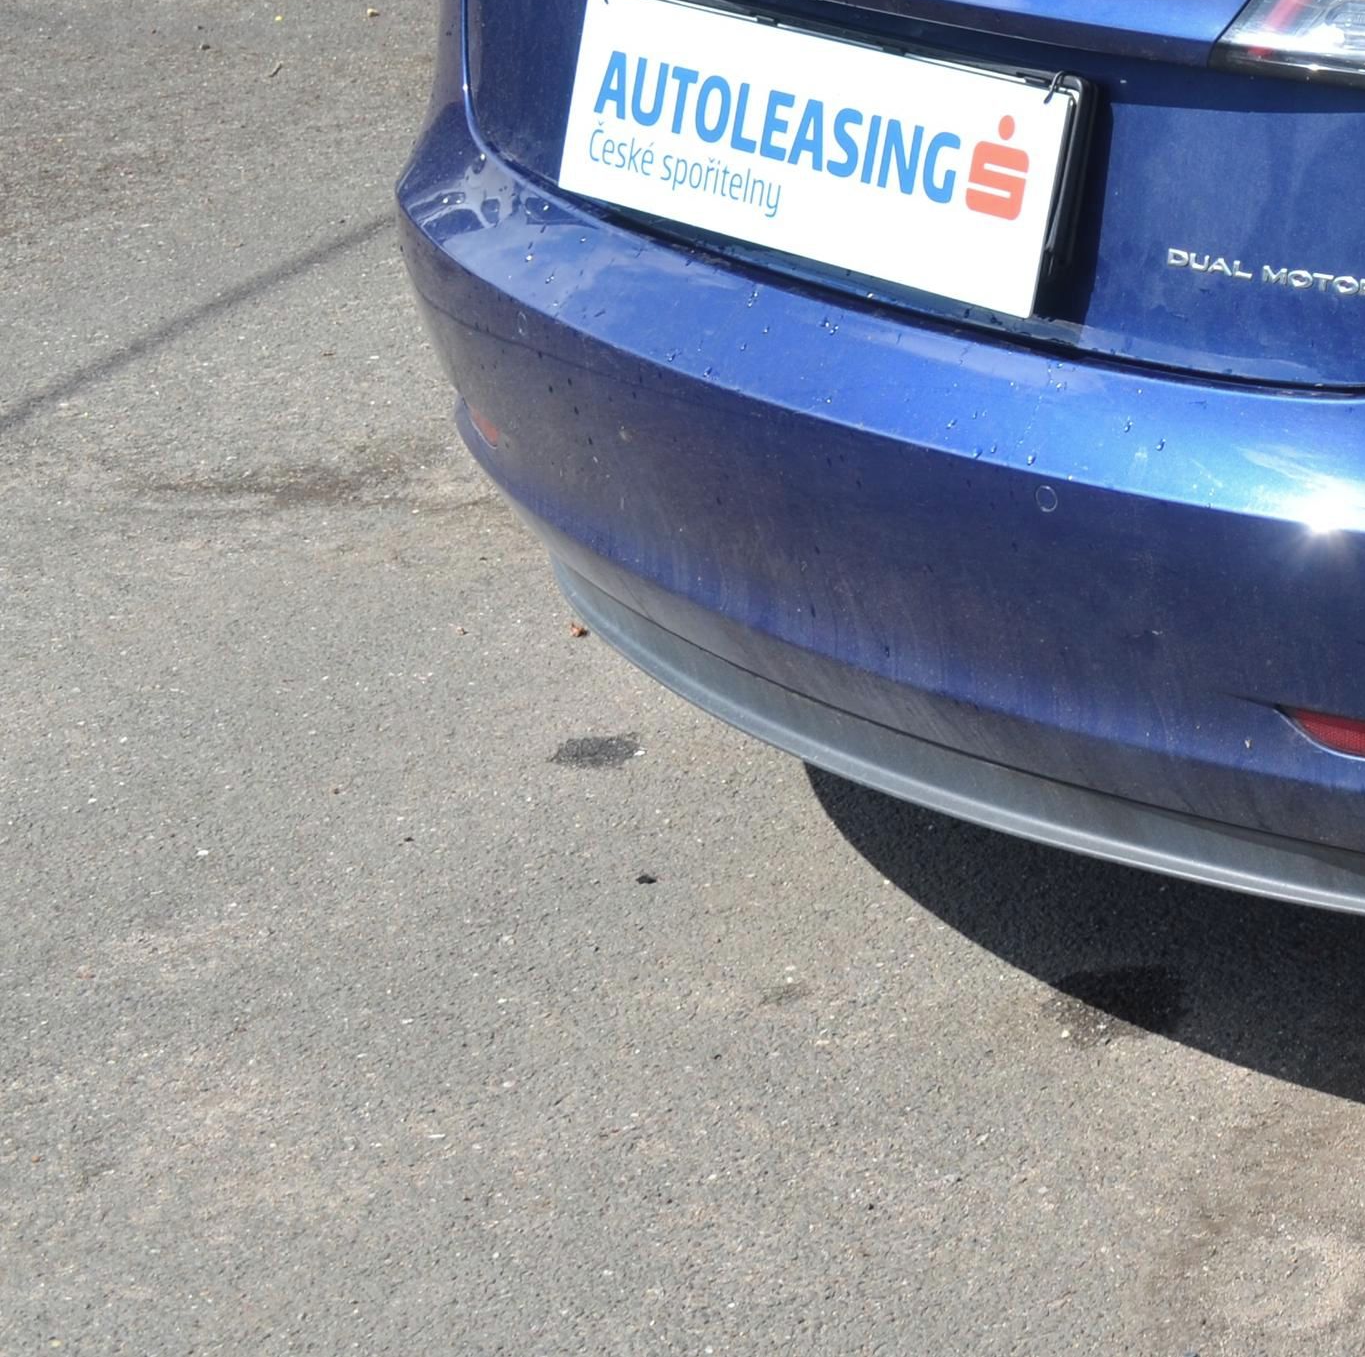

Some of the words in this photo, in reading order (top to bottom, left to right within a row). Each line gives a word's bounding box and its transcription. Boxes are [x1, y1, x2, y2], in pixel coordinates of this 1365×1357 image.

[588, 121, 656, 178] České
[659, 156, 782, 219] spořitelny
[594, 50, 961, 204] AUTOLEASING
[1167, 248, 1253, 280] DUAL
